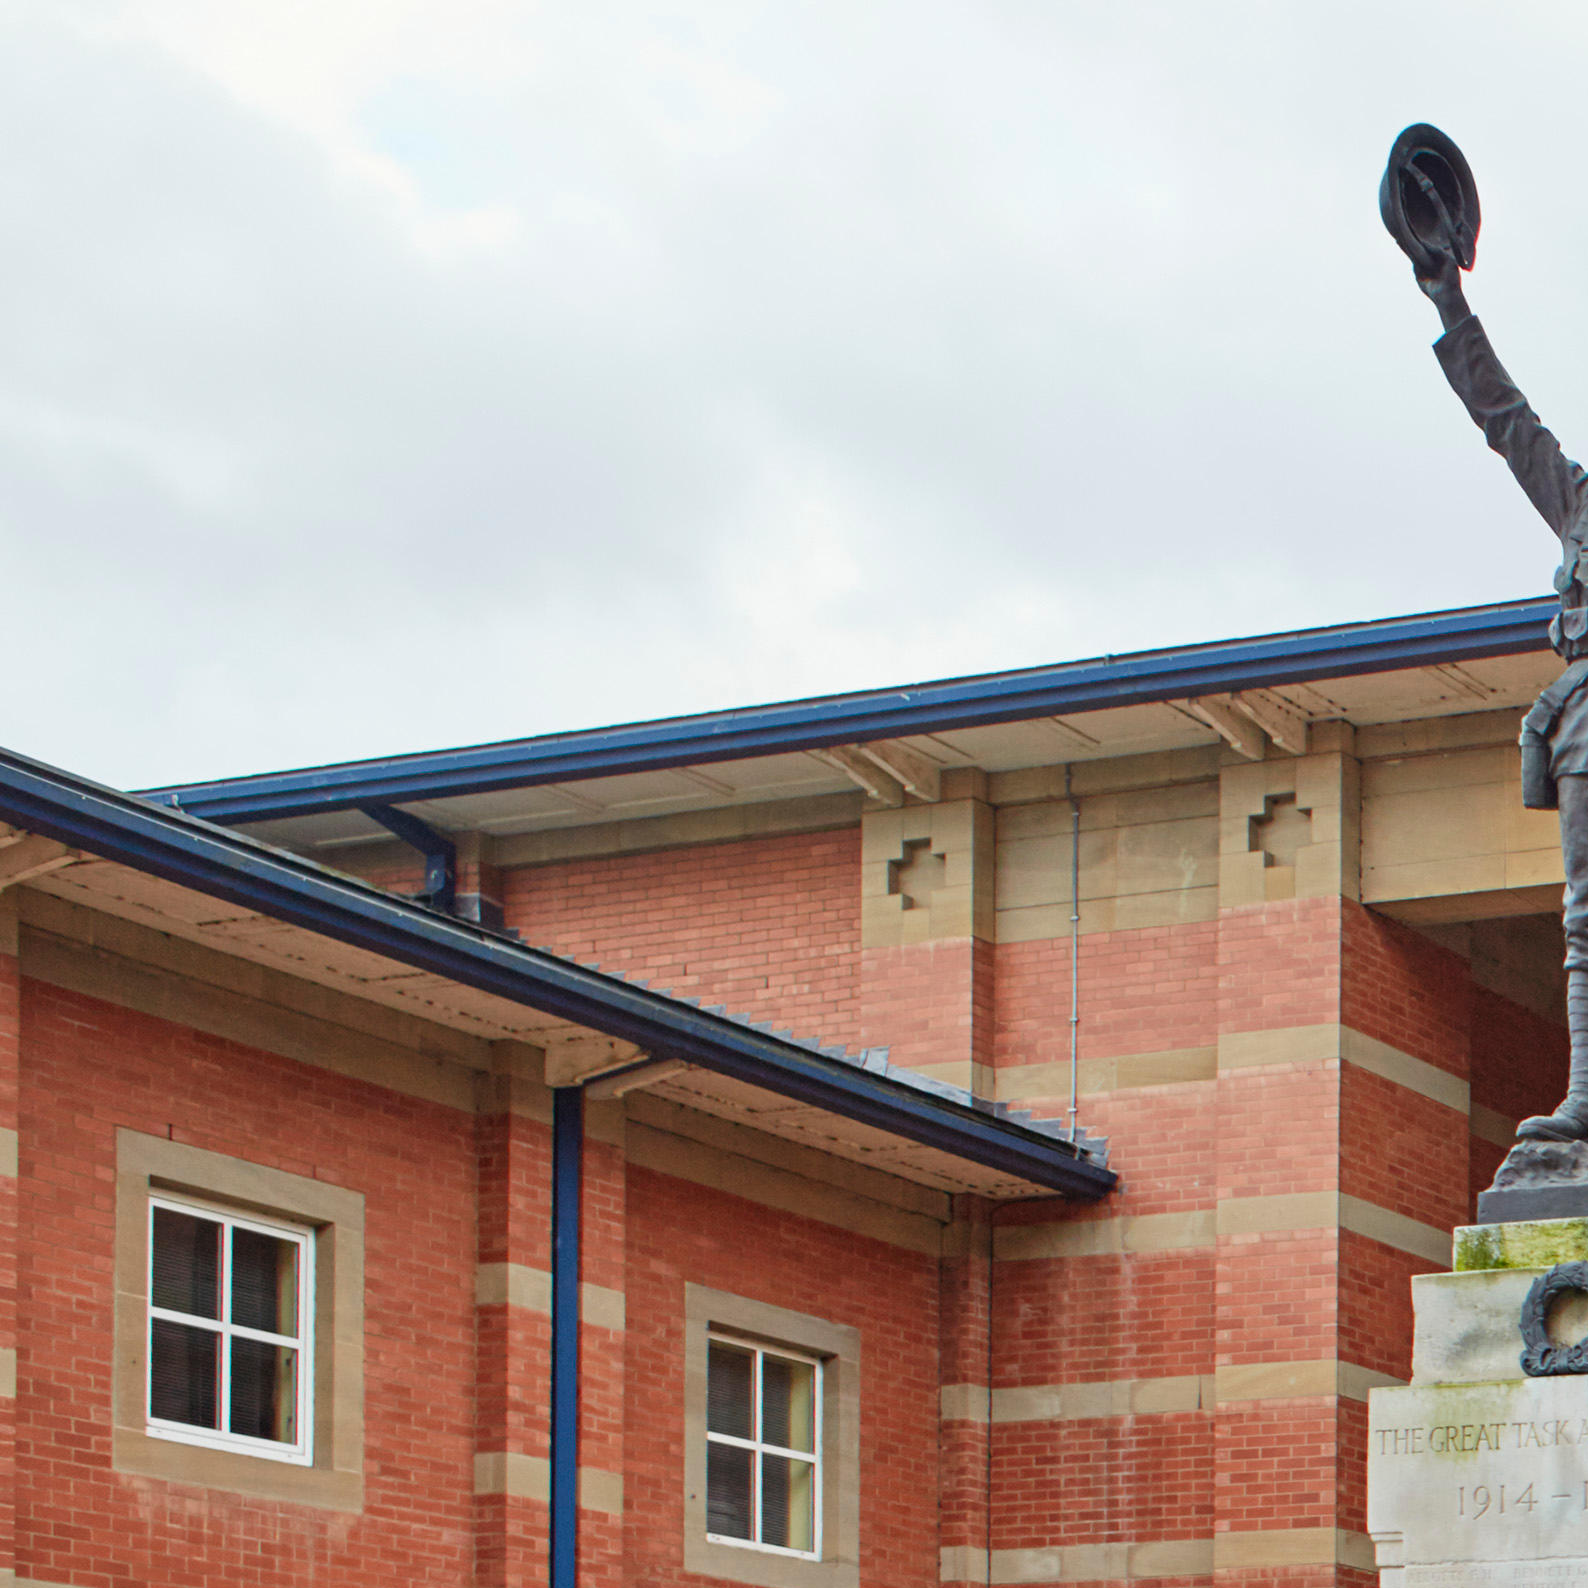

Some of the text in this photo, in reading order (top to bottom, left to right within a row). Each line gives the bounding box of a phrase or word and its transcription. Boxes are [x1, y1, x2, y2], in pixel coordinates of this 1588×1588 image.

[1374, 1426, 1423, 1456] THE
[1429, 1421, 1506, 1453] GREAT
[1512, 1417, 1570, 1448] TASK
[1458, 1482, 1539, 1520] 1914
